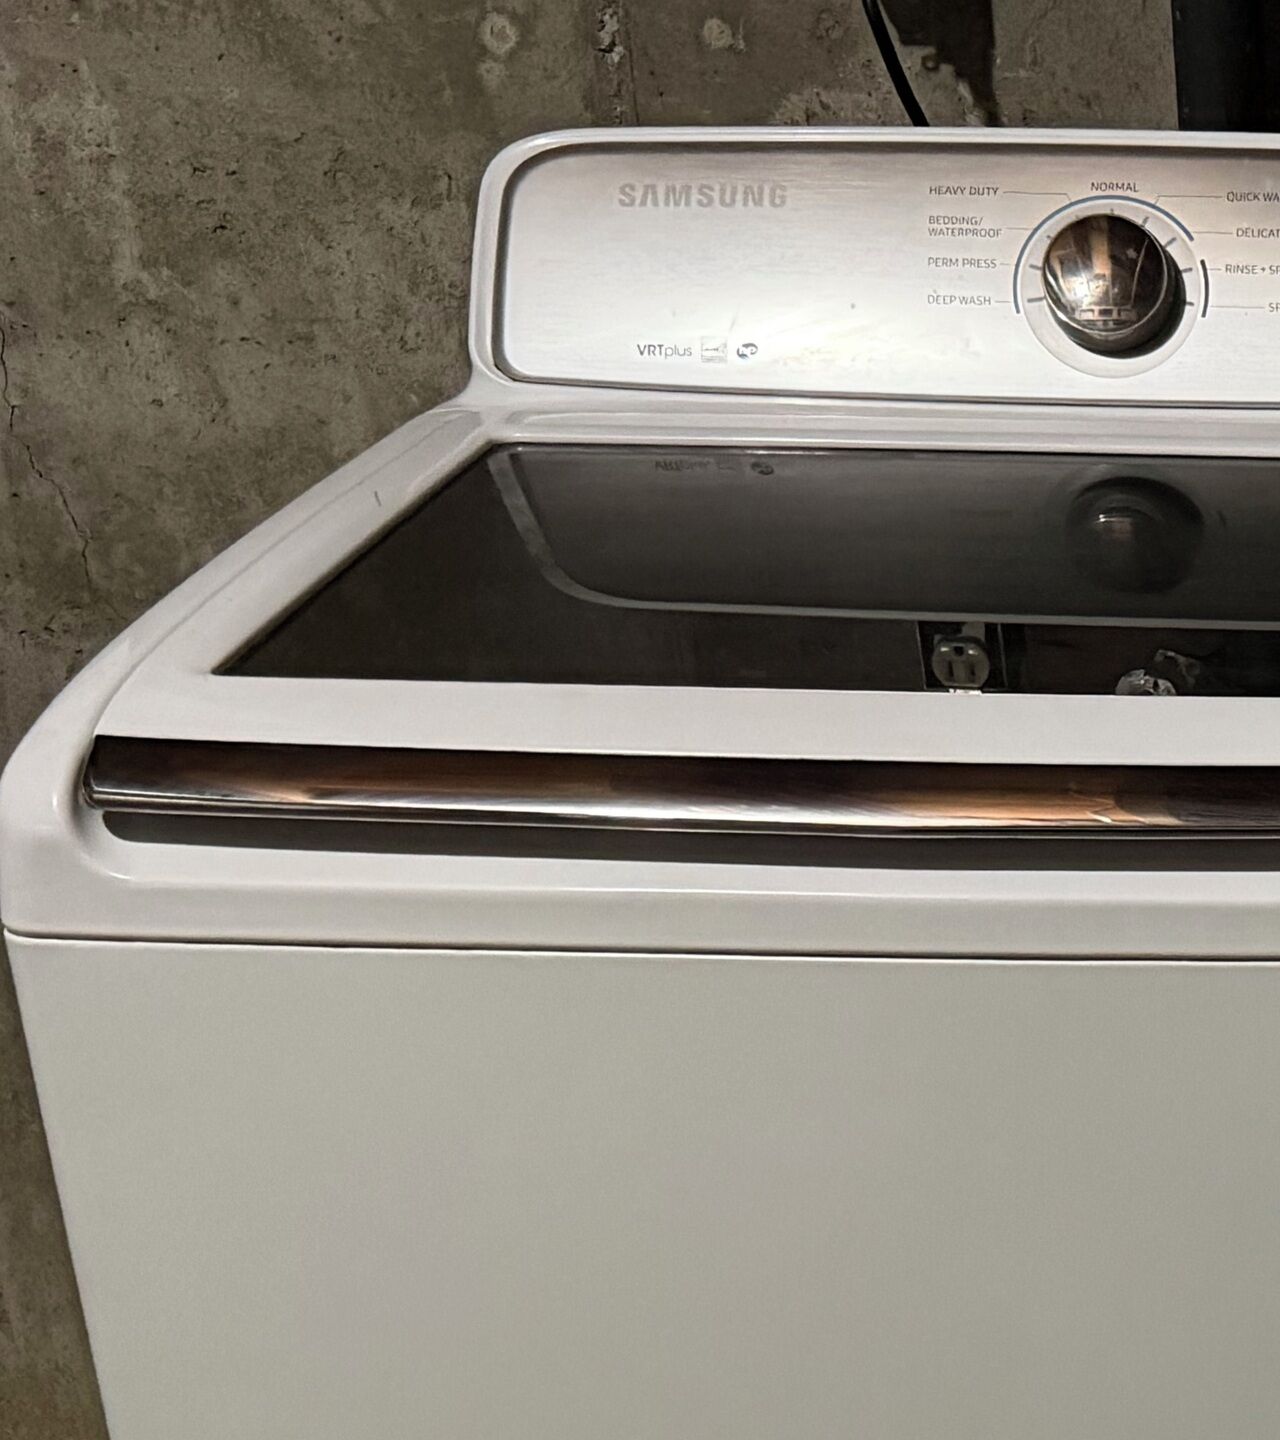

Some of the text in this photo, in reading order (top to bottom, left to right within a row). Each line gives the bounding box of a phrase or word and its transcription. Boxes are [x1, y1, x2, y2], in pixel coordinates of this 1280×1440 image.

[929, 186, 999, 196] HEAVY DUTY
[1090, 182, 1139, 193] NORMAL
[617, 183, 788, 208] SAMSUNG
[1226, 191, 1260, 203] QUICK
[928, 215, 984, 226] BEDDING/
[928, 227, 1002, 238] WATERPROOF
[927, 258, 997, 269] PERM PRESS
[1225, 264, 1257, 275] RINSE
[927, 295, 992, 306] DEEP WASH
[637, 344, 692, 359] VRTplus
